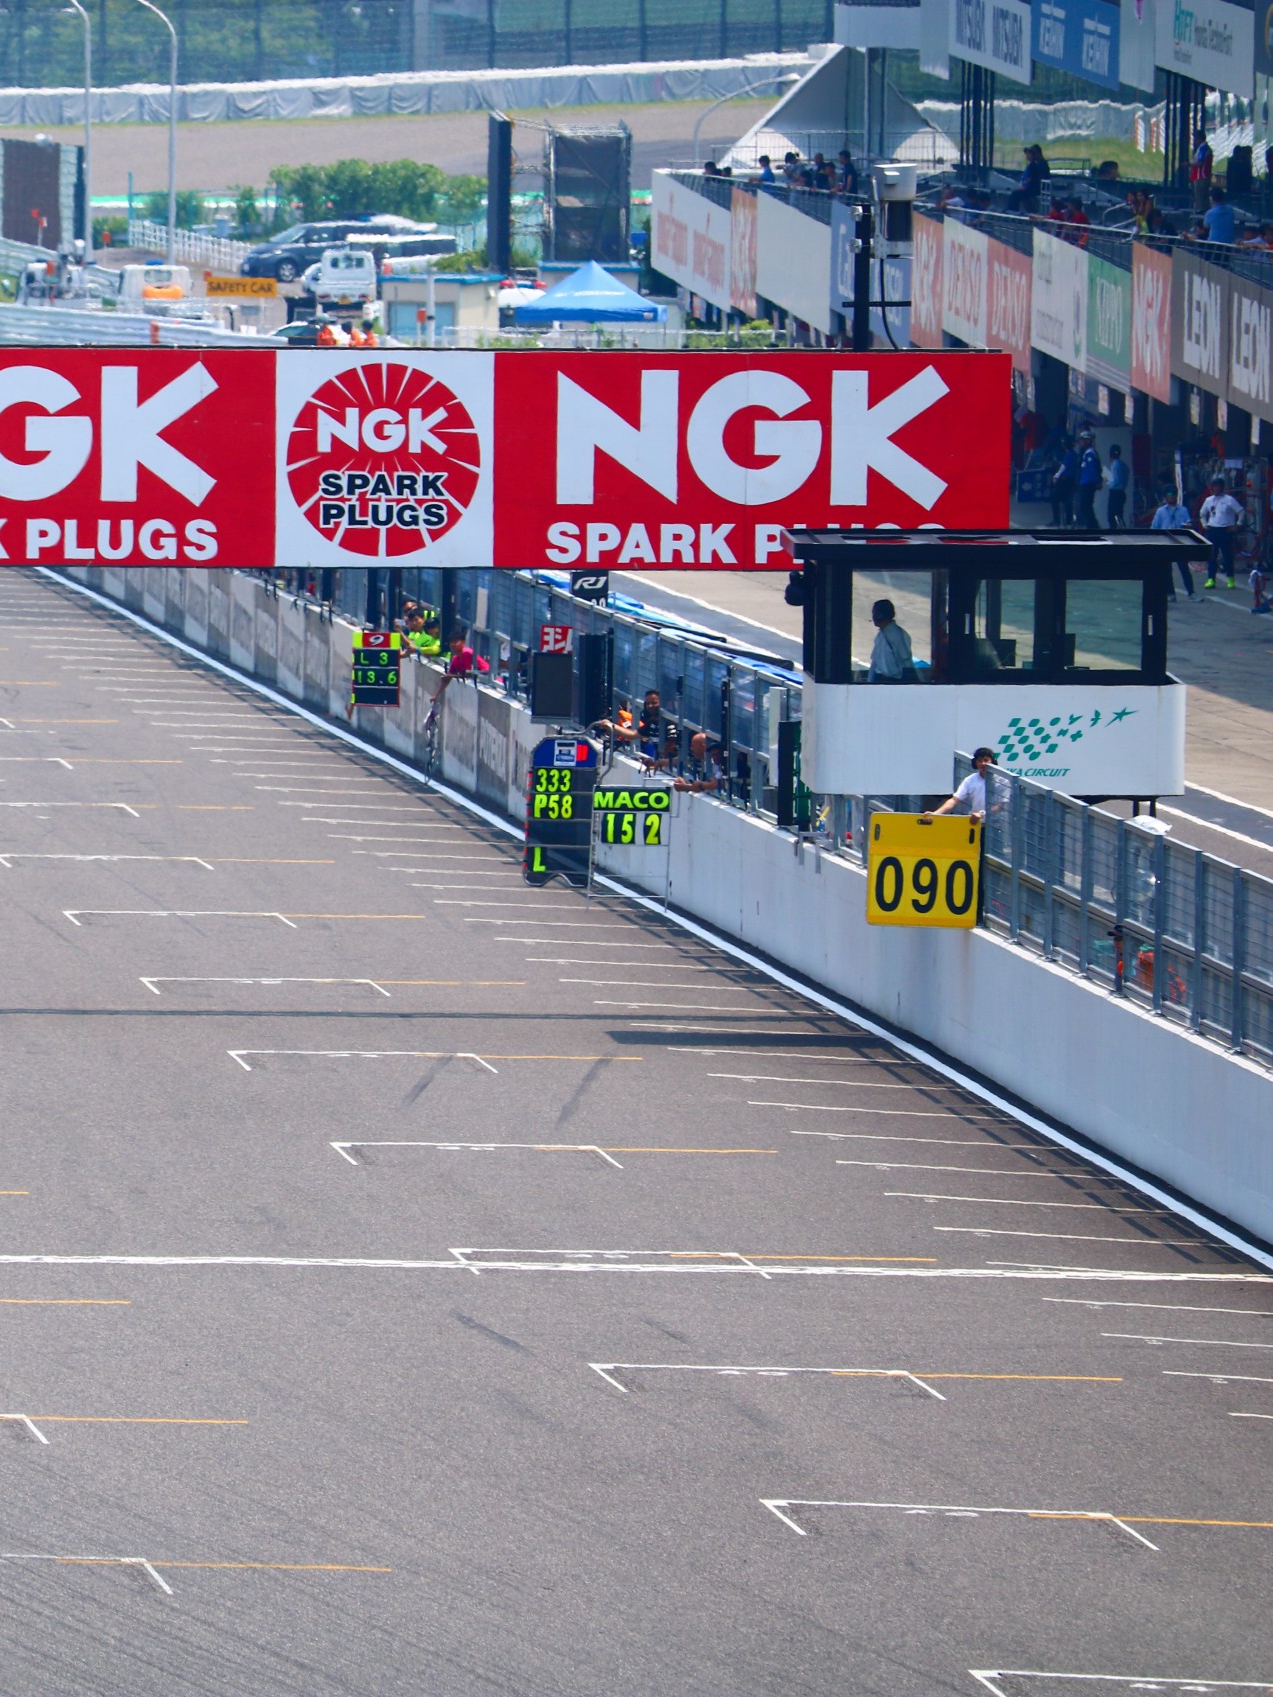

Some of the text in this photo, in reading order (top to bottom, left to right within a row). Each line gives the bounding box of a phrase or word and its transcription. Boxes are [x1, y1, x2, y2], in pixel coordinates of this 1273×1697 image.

[209, 281, 273, 293] SAFETY CAR
[992, 261, 1027, 351] DENSO
[1183, 270, 1221, 379] LEON
[1233, 291, 1270, 403] LEON
[317, 406, 448, 454] NGK
[556, 364, 950, 511] NGK
[319, 471, 448, 499] SPARK
[320, 501, 447, 529] PLUGS
[25, 518, 219, 561] PLUGS
[545, 521, 738, 564] SPARK
[360, 652, 388, 665] L 3
[535, 768, 572, 793] 333
[1024, 768, 1070, 777] CIRCUIT
[533, 793, 573, 820] P58
[593, 791, 670, 810] MACO
[532, 846, 546, 873] L
[874, 856, 974, 916] 090
